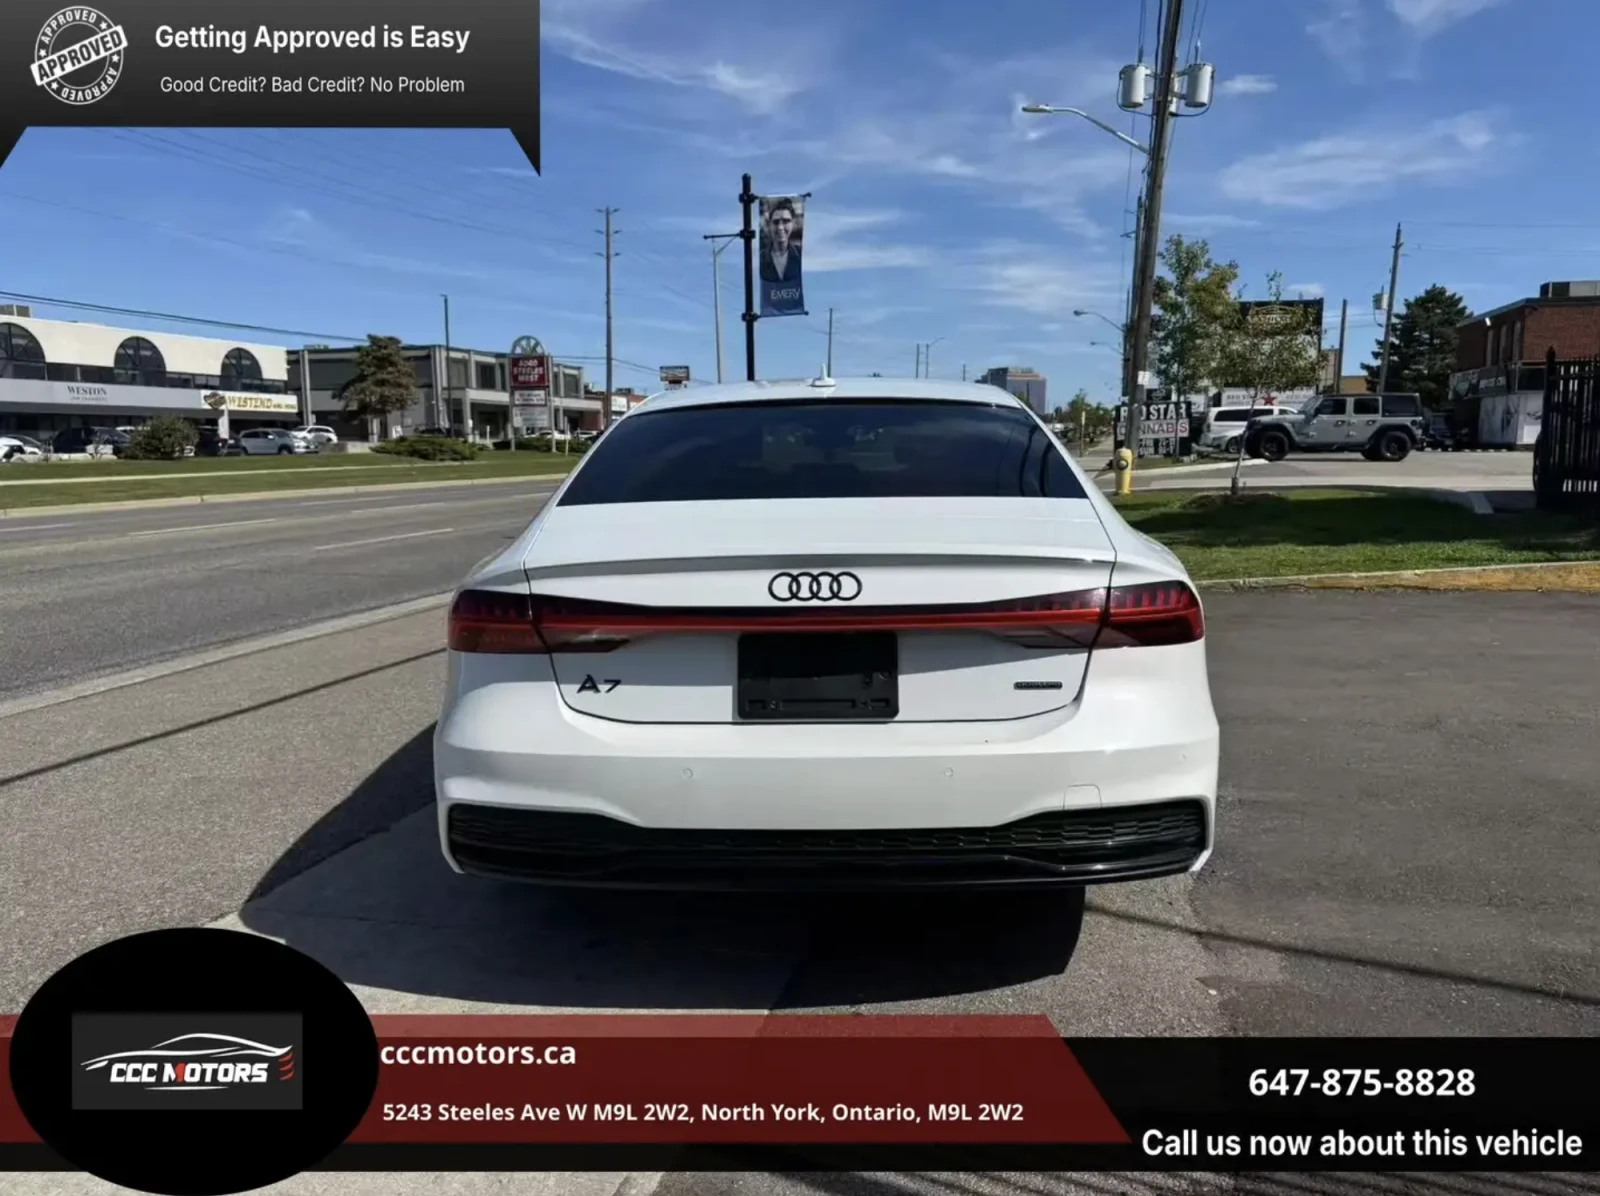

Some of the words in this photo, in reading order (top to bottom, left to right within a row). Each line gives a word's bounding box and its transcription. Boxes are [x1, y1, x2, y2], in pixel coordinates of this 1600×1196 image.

[770, 288, 801, 300] EMERY
[67, 385, 108, 396] WESTON
[228, 395, 273, 409] WESTEND
[576, 674, 622, 694] A7
